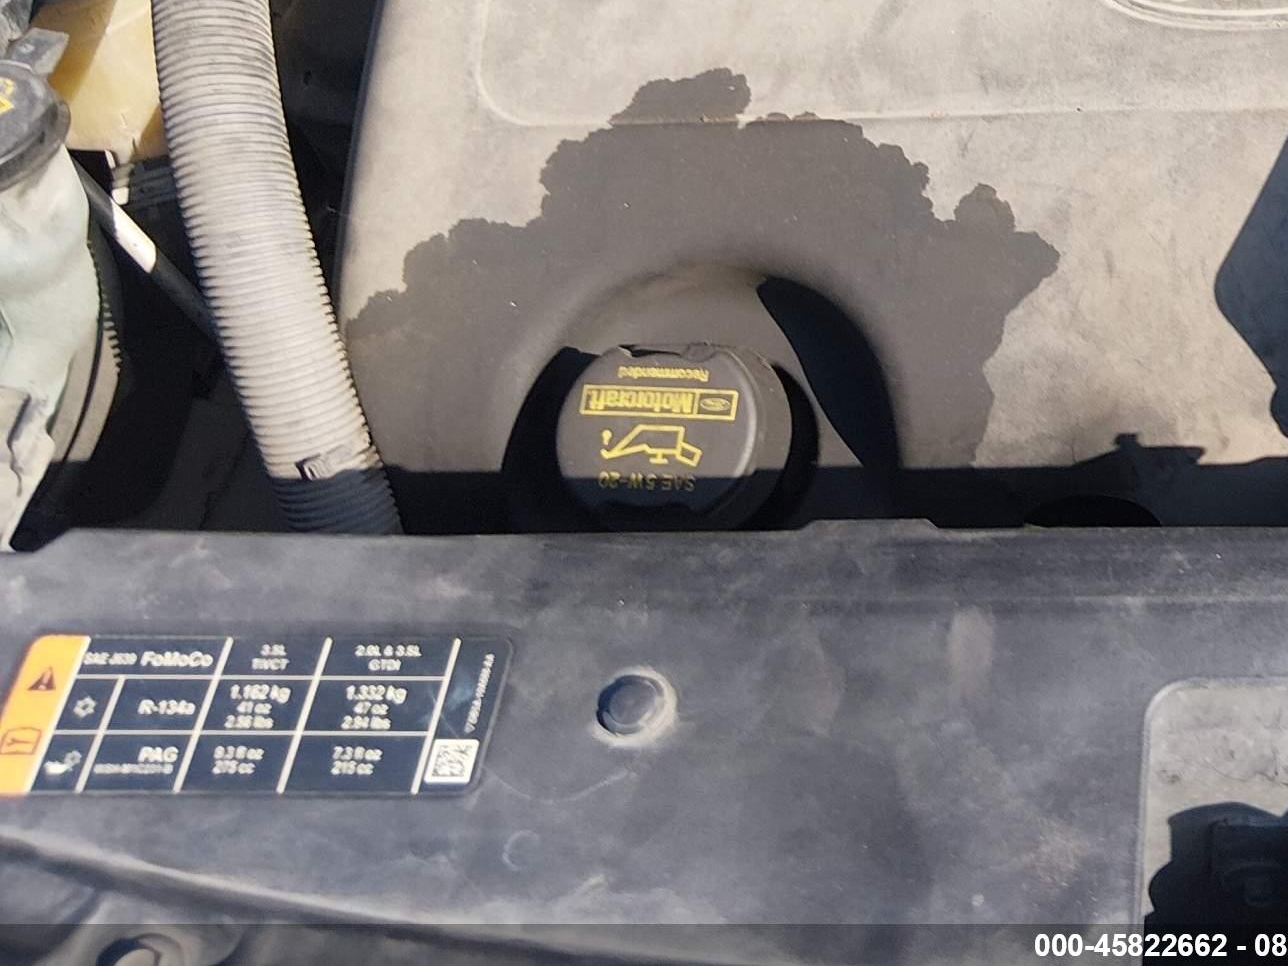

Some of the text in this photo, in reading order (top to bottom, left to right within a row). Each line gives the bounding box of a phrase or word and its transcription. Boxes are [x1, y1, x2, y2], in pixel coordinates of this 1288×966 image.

[618, 366, 709, 382] Recommended
[589, 388, 695, 414] Motorcraft
[598, 471, 696, 492] SAE 5W-20
[140, 650, 214, 667] FoMoCo
[270, 685, 292, 705] kg
[346, 685, 408, 705] 1.332 kg
[137, 698, 196, 715] R-134a
[254, 702, 273, 715] oz
[370, 703, 389, 715] oz
[137, 745, 179, 762] PAG
[247, 748, 265, 761] oz
[364, 748, 383, 761] oz
